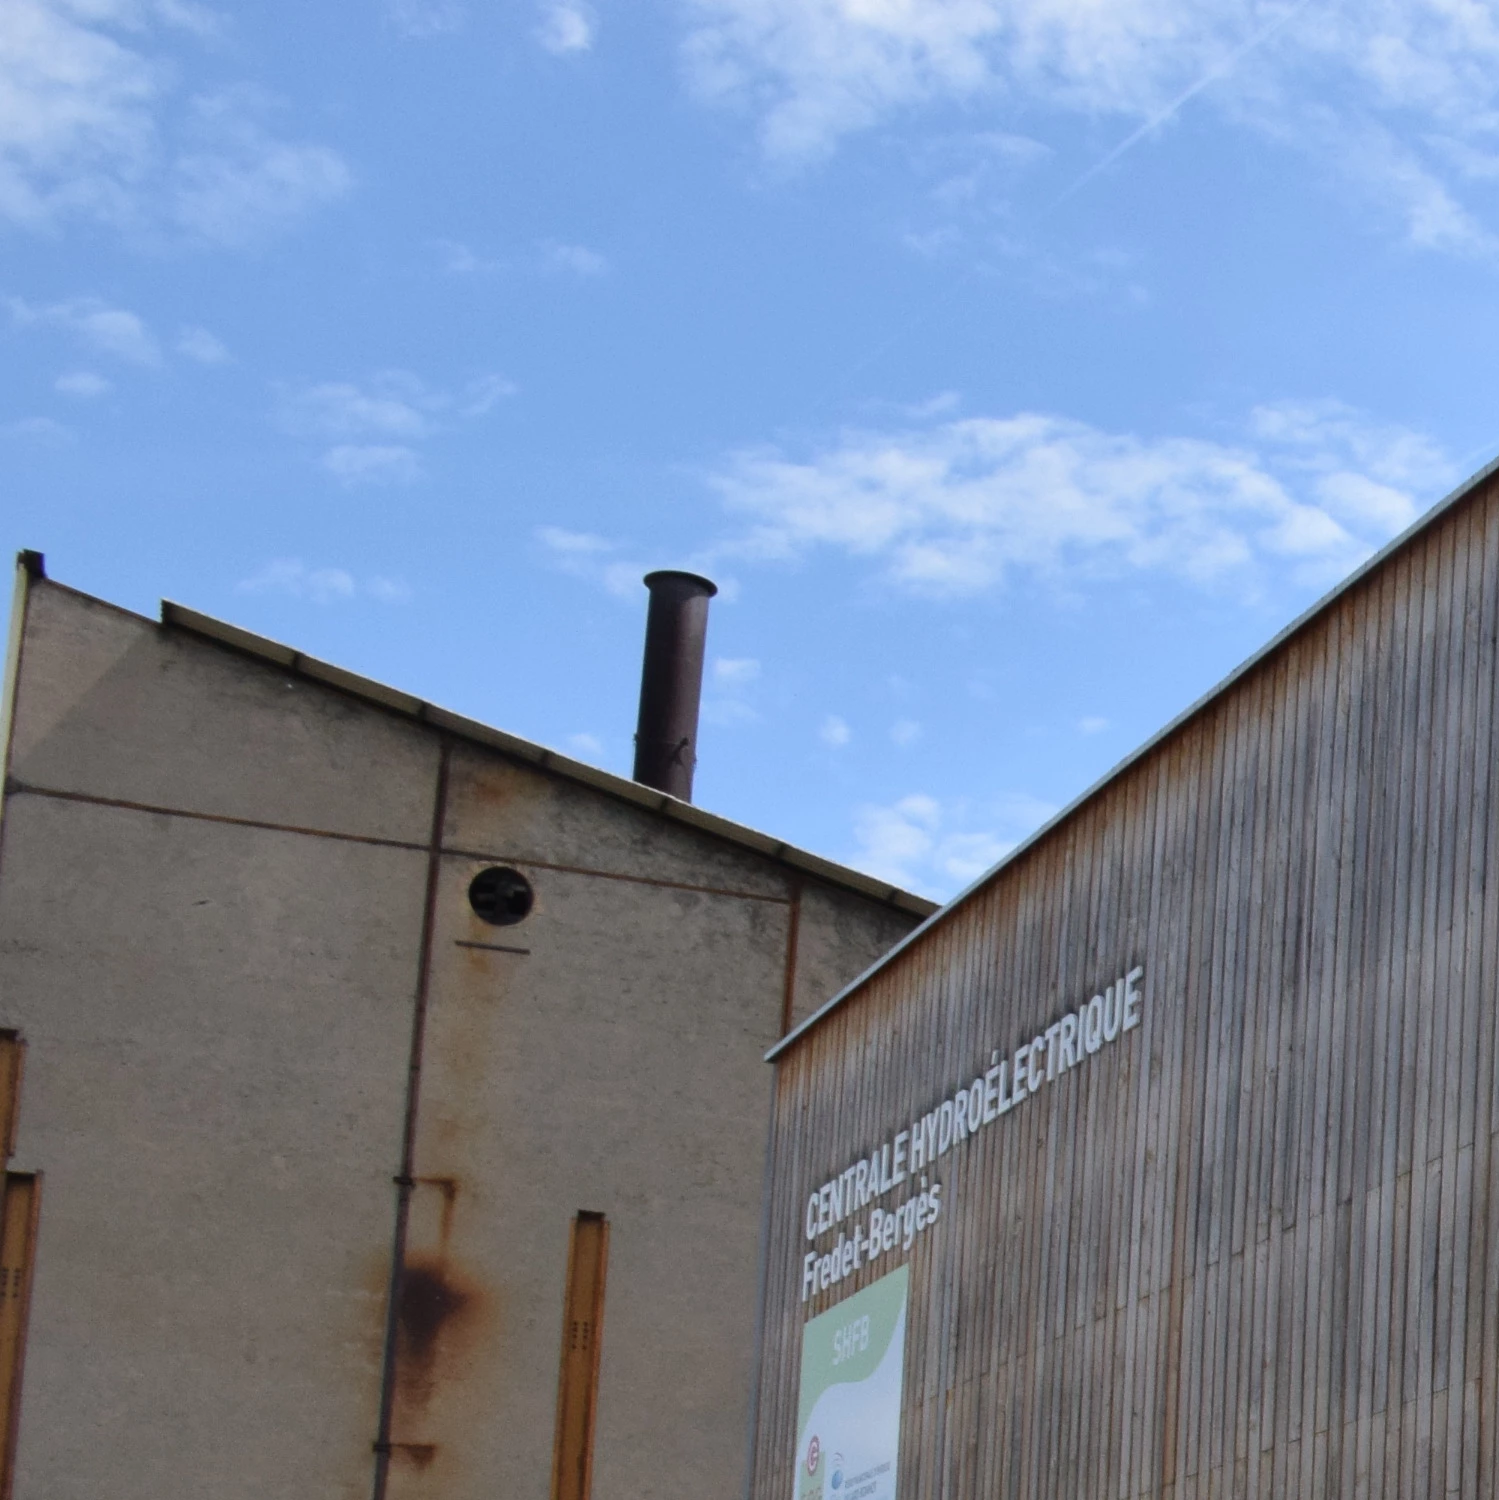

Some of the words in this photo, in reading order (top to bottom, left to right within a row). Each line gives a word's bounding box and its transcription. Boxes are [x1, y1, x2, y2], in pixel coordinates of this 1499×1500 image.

[806, 1129, 909, 1240] CENTRALE
[910, 965, 1143, 1174] HYDROÉLECTRIQUE
[802, 1175, 942, 1302] Fredet-Bergès
[832, 1315, 870, 1366] SHFB
